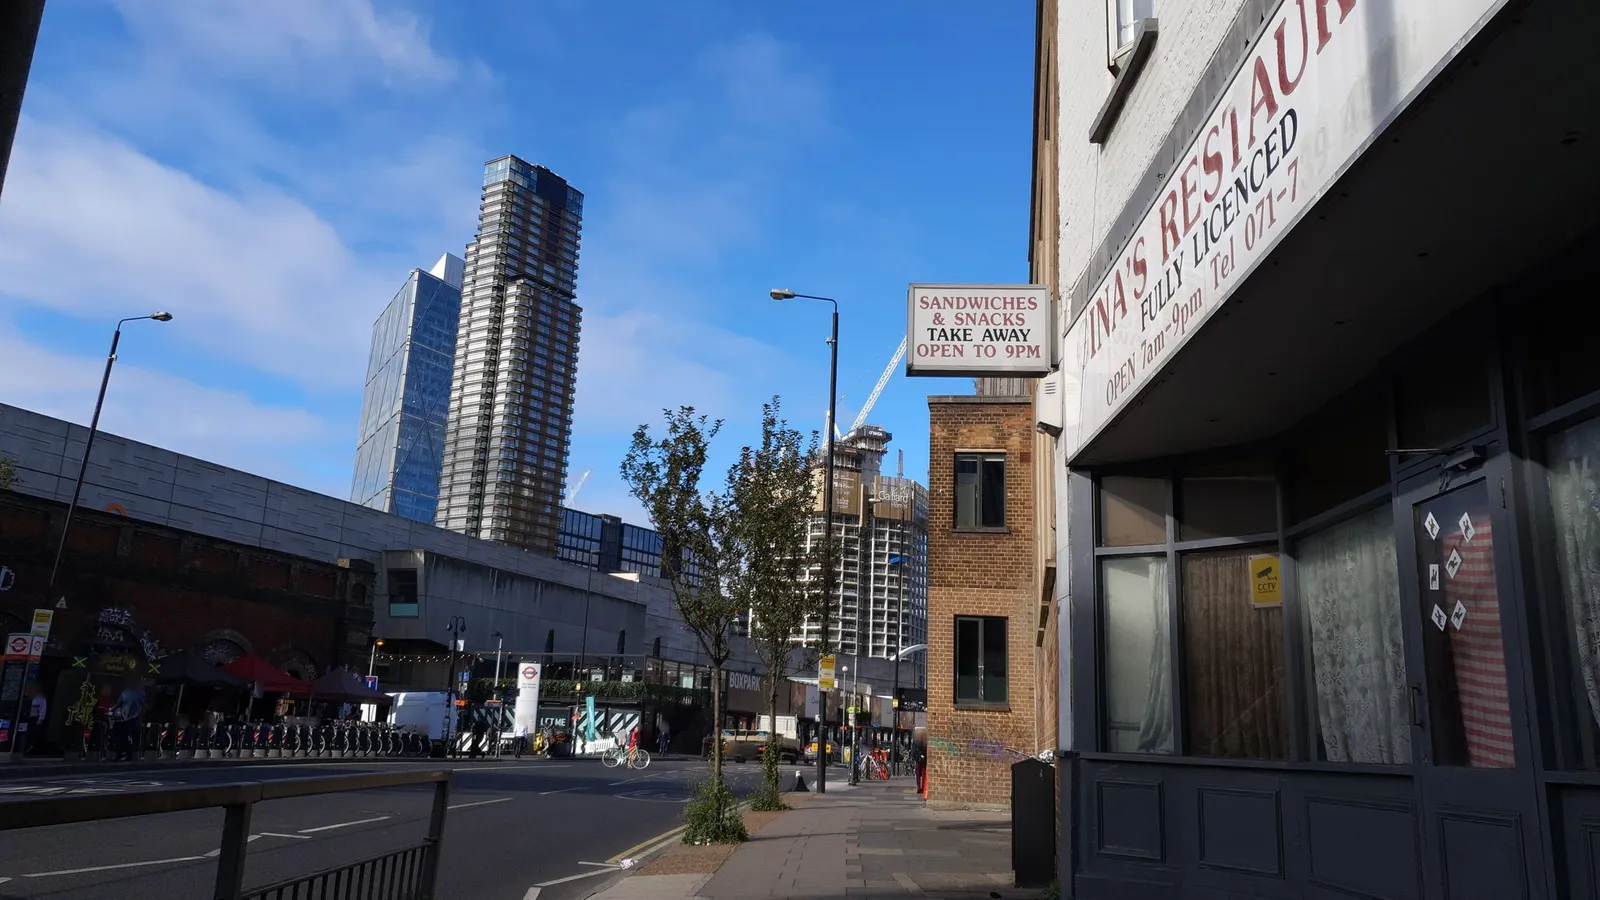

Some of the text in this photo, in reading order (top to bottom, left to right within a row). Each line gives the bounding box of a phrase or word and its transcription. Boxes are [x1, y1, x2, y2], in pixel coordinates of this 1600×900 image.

[1141, 107, 1298, 333] FULLY LICENCED
[919, 295, 1038, 311] SANDWICHES
[1088, 237, 1148, 360] INA'S
[932, 312, 1026, 326] & SNACKS
[1106, 353, 1137, 408] OPEN
[1141, 284, 1204, 370] 7am-9pm
[1210, 236, 1236, 292] Tel
[927, 327, 1031, 342] TAKE AWAY
[916, 343, 1041, 359] OPEN TO 9PM
[1257, 582, 1276, 591] CCTV
[729, 671, 761, 692] BOXPARK
[554, 717, 566, 727] ME
